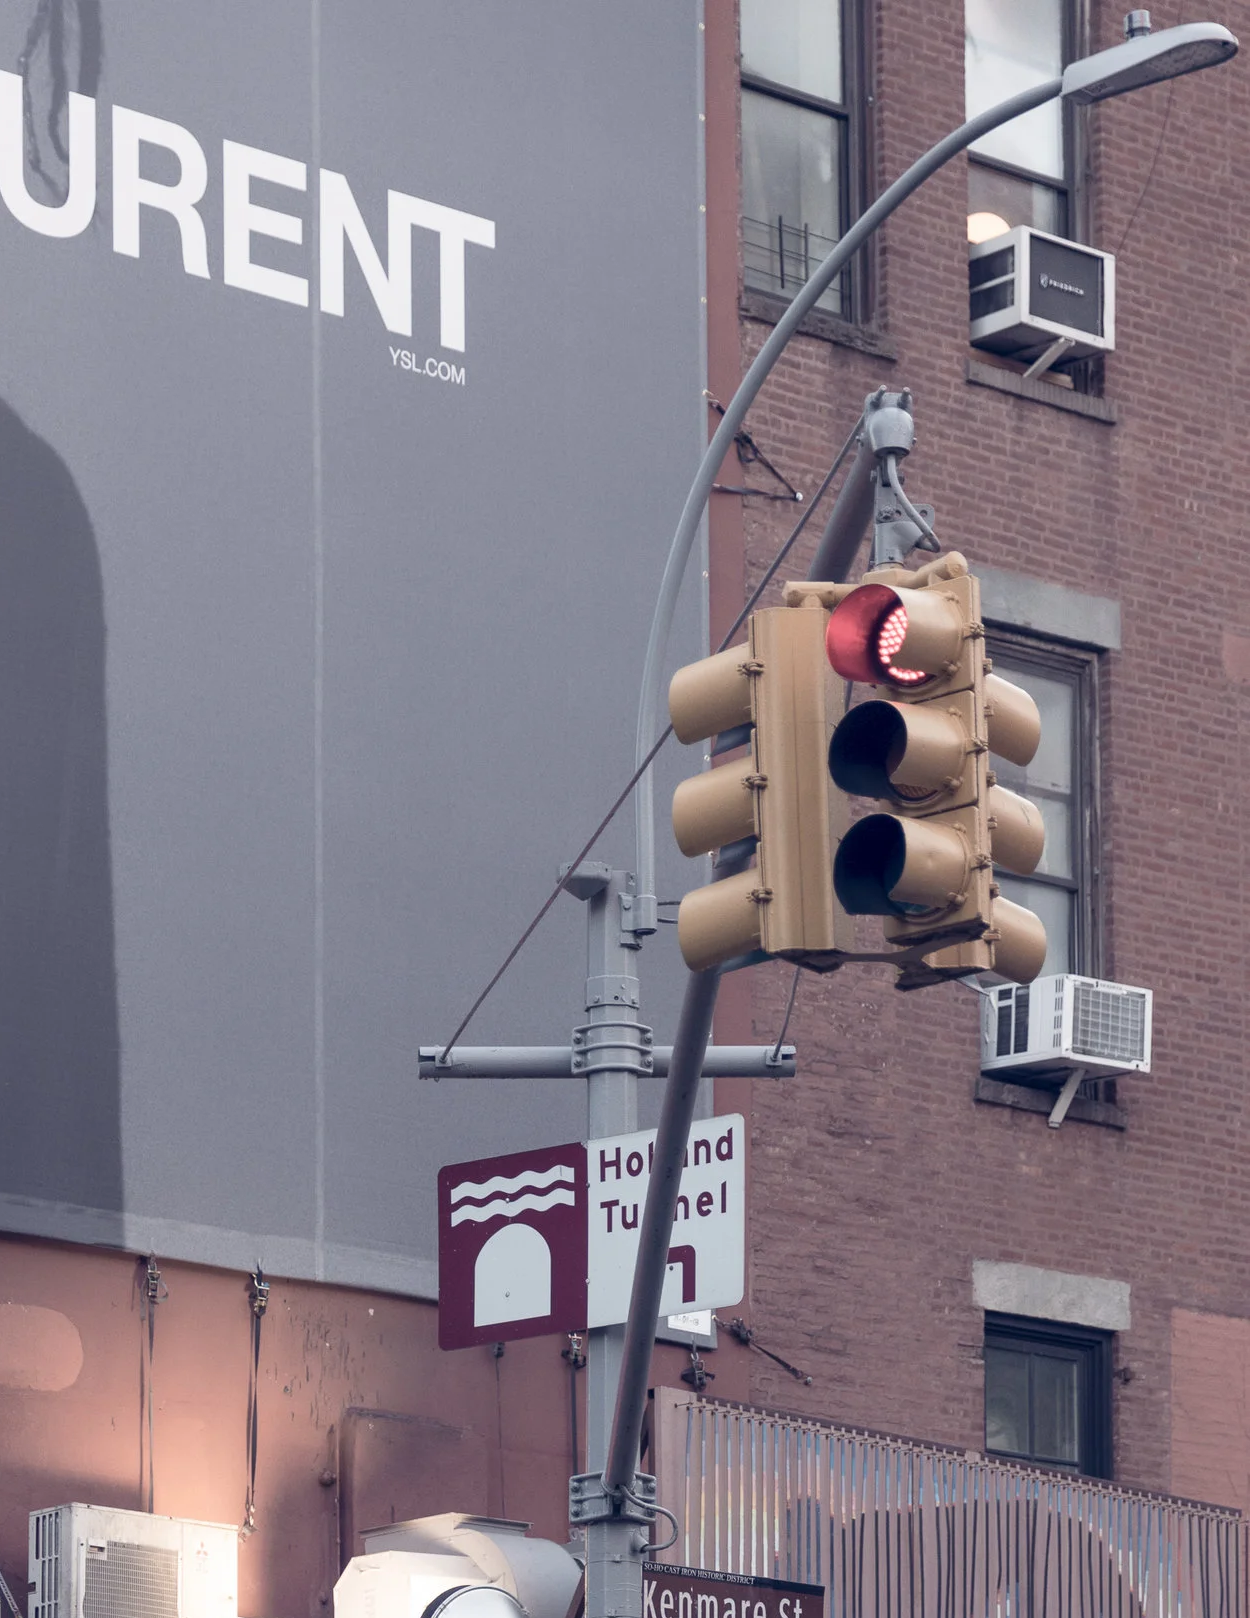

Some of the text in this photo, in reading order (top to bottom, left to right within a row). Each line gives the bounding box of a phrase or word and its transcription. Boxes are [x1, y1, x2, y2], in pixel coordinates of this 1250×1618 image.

[388, 346, 466, 386] YSL.COM
[599, 1127, 733, 1182] Holnd
[599, 1181, 727, 1233] Tunel
[664, 1566, 680, 1574] CAST
[681, 1567, 697, 1577] IRON
[697, 1570, 726, 1582] HISTORIC
[726, 1574, 756, 1585] DISTRICT
